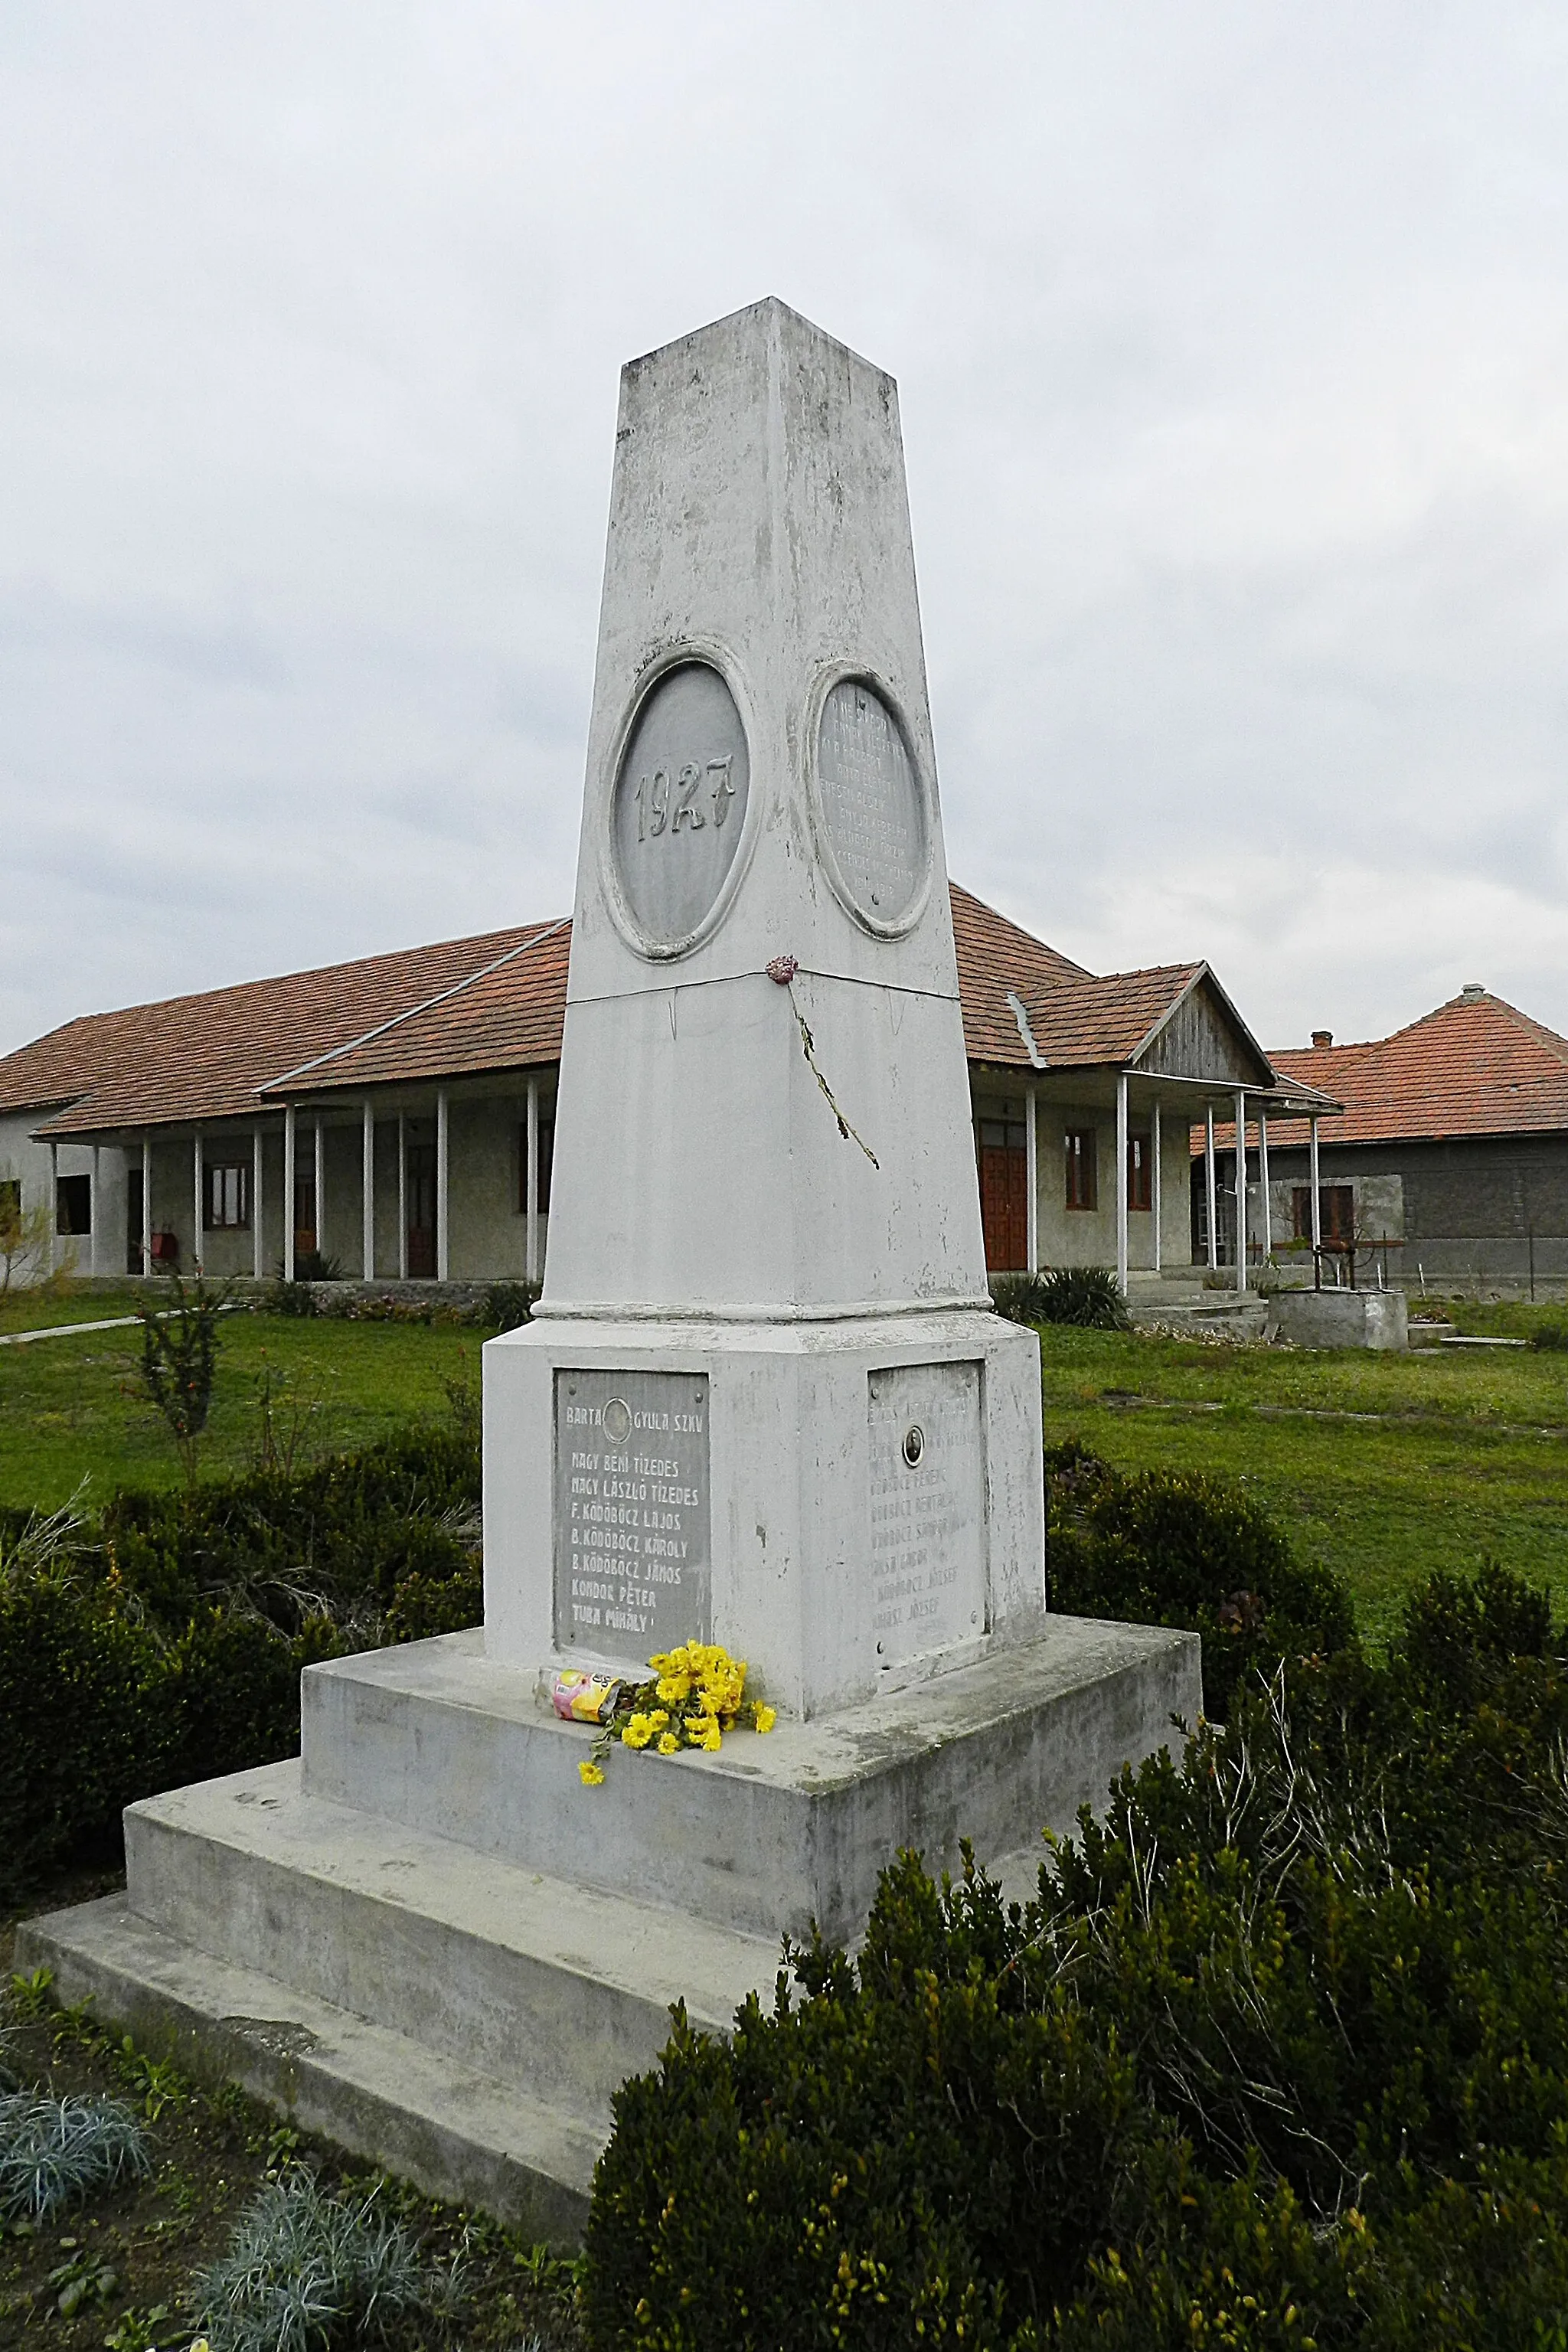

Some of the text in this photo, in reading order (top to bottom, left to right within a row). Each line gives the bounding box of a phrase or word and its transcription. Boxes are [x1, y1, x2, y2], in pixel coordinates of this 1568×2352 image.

[634, 754, 735, 842] 1927
[566, 1406, 602, 1426] BARTA
[634, 1411, 669, 1431] GYULA
[571, 1452, 599, 1471] NAGY
[571, 1476, 599, 1495] NAGY
[643, 1510, 681, 1530] LAJOS
[644, 1559, 681, 1584] JÁNOS
[571, 1578, 656, 1608] KONDOR PÉTER
